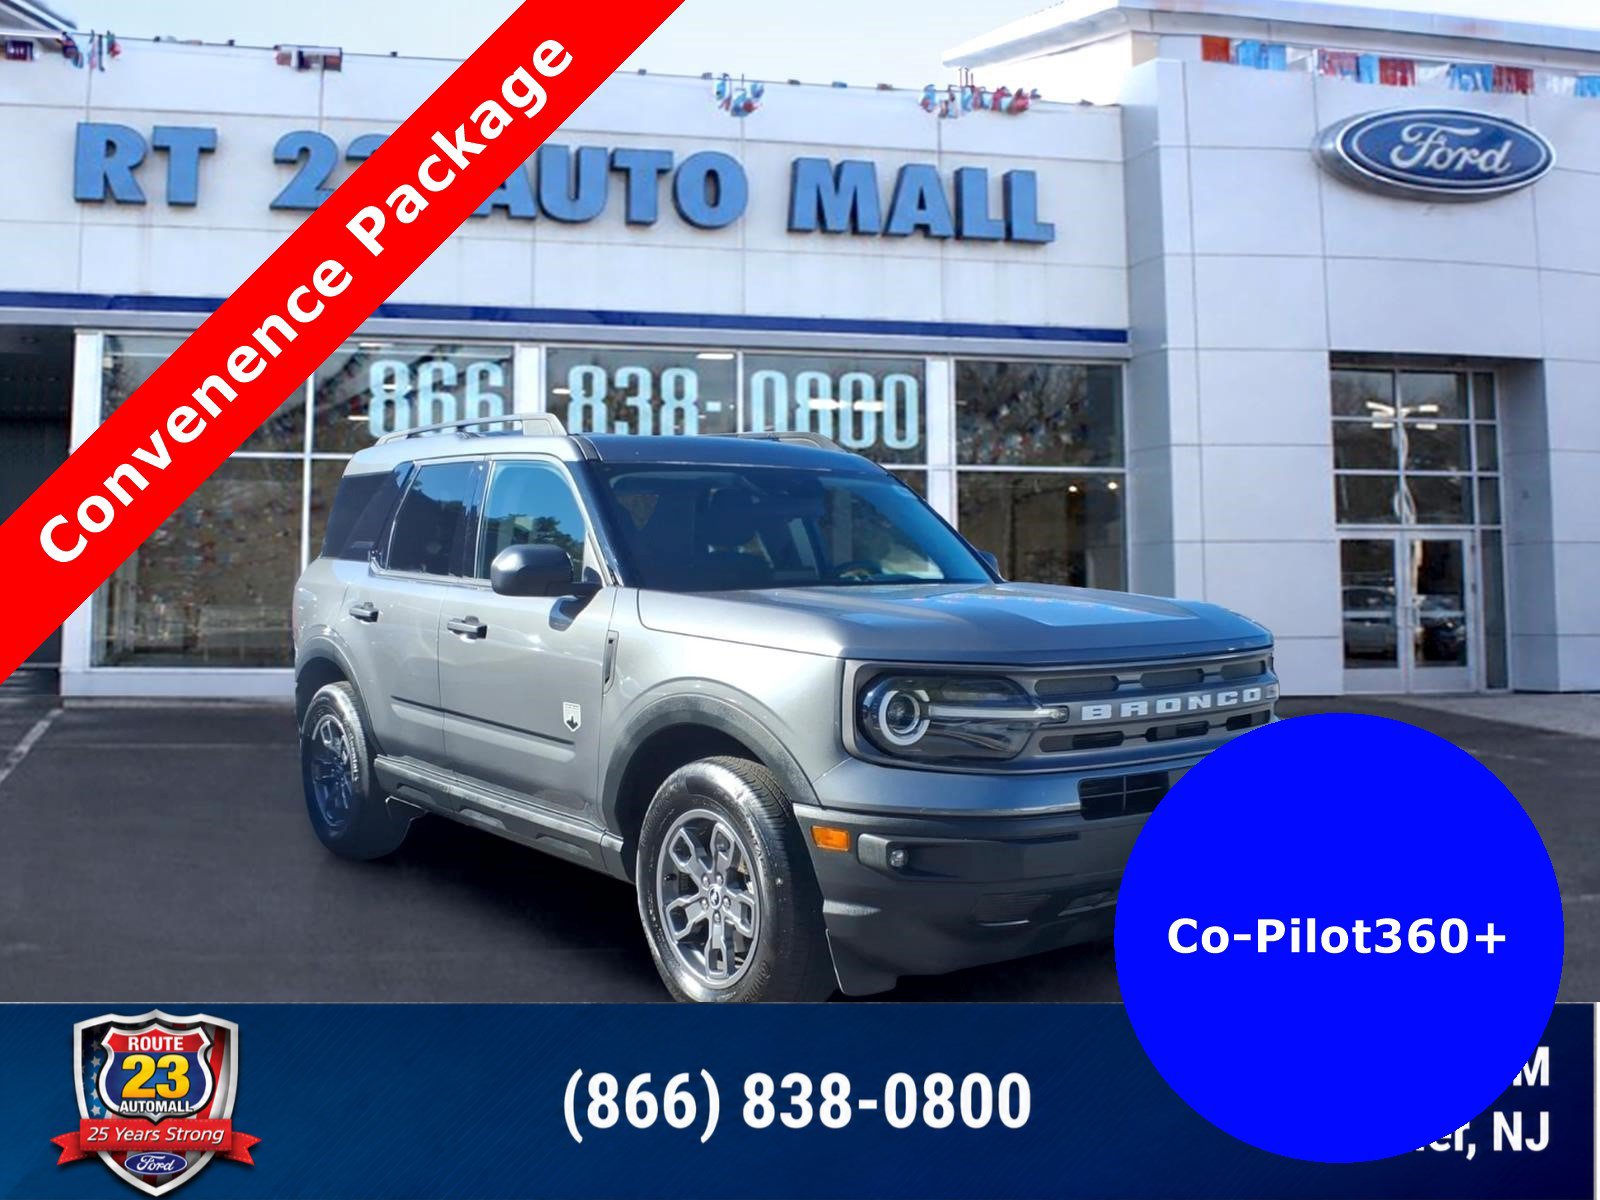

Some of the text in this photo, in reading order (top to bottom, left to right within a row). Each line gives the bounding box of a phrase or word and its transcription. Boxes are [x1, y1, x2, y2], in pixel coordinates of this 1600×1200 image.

[1389, 120, 1513, 175] Ford
[73, 122, 218, 207] RT
[787, 157, 1056, 244] MALL
[369, 360, 504, 439] 866
[1081, 687, 1262, 721] BRONCO
